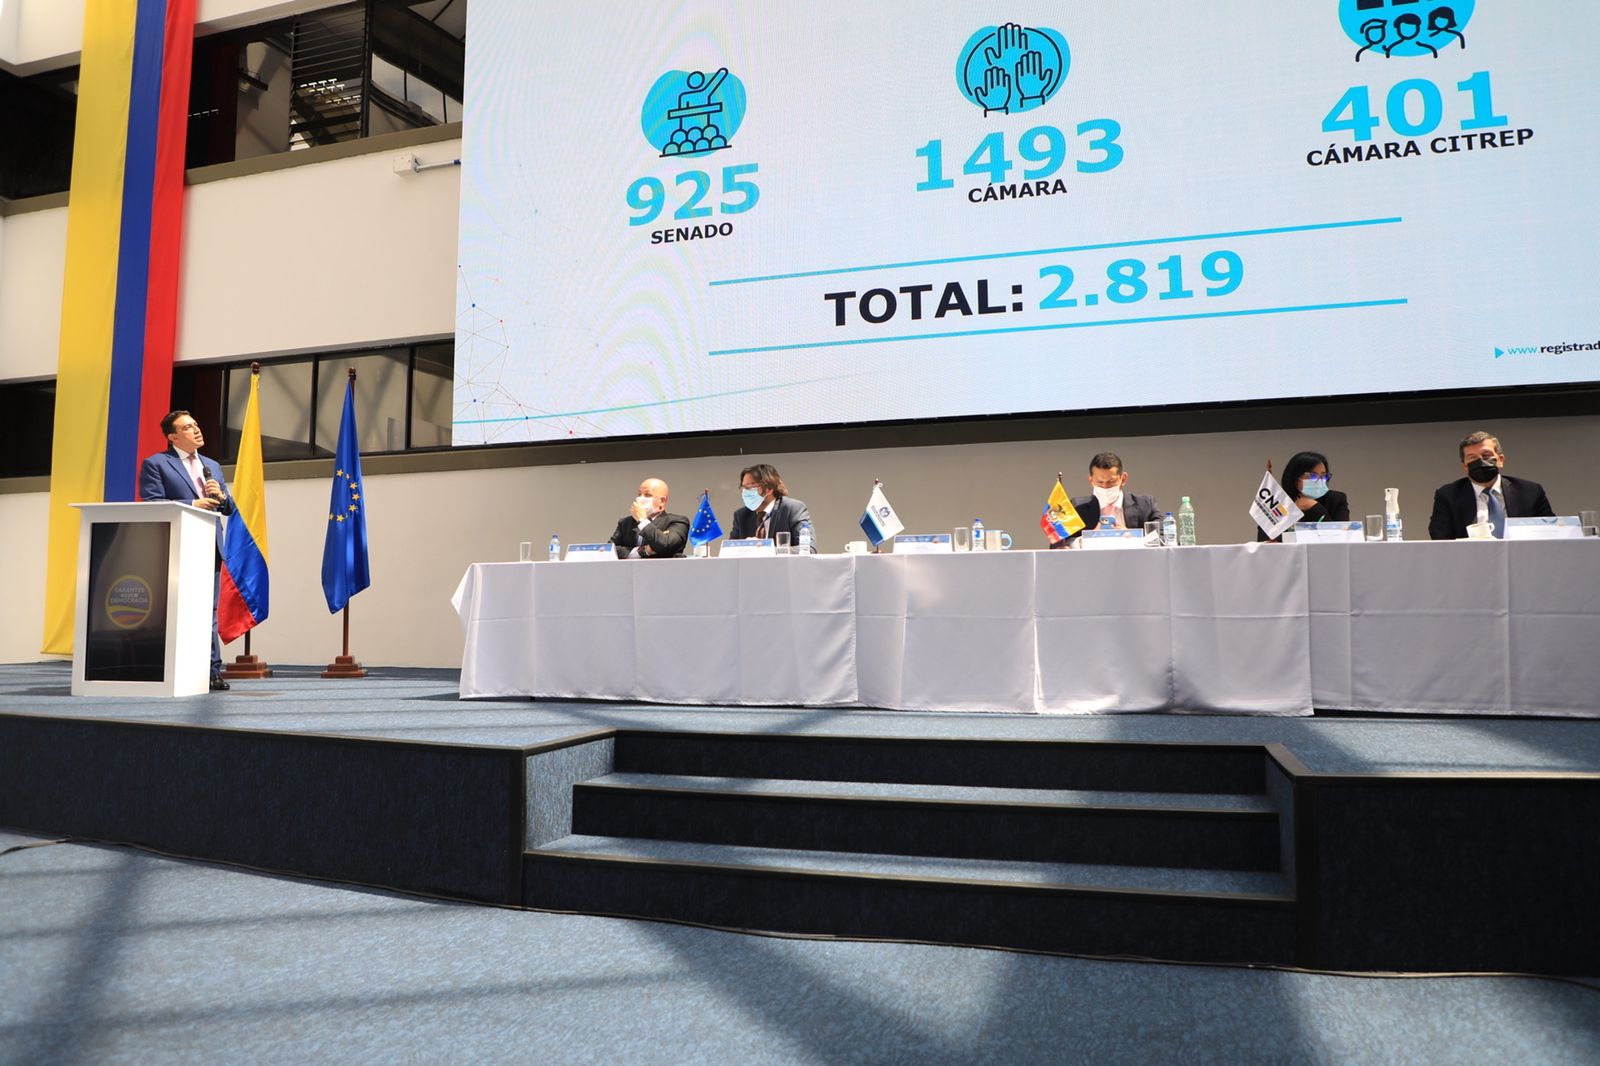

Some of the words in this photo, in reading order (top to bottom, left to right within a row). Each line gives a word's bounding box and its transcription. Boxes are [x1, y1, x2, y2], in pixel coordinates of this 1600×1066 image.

[1322, 71, 1508, 141] 401
[917, 119, 1123, 191] 1493
[1307, 140, 1421, 166] CÁMARA
[1431, 129, 1533, 154] CITREP
[626, 164, 759, 225] 925
[969, 178, 1067, 203] CÁMARA
[651, 223, 733, 244] SENADO
[825, 280, 1022, 326] TOTAL:
[1040, 251, 1243, 309] 2.819
